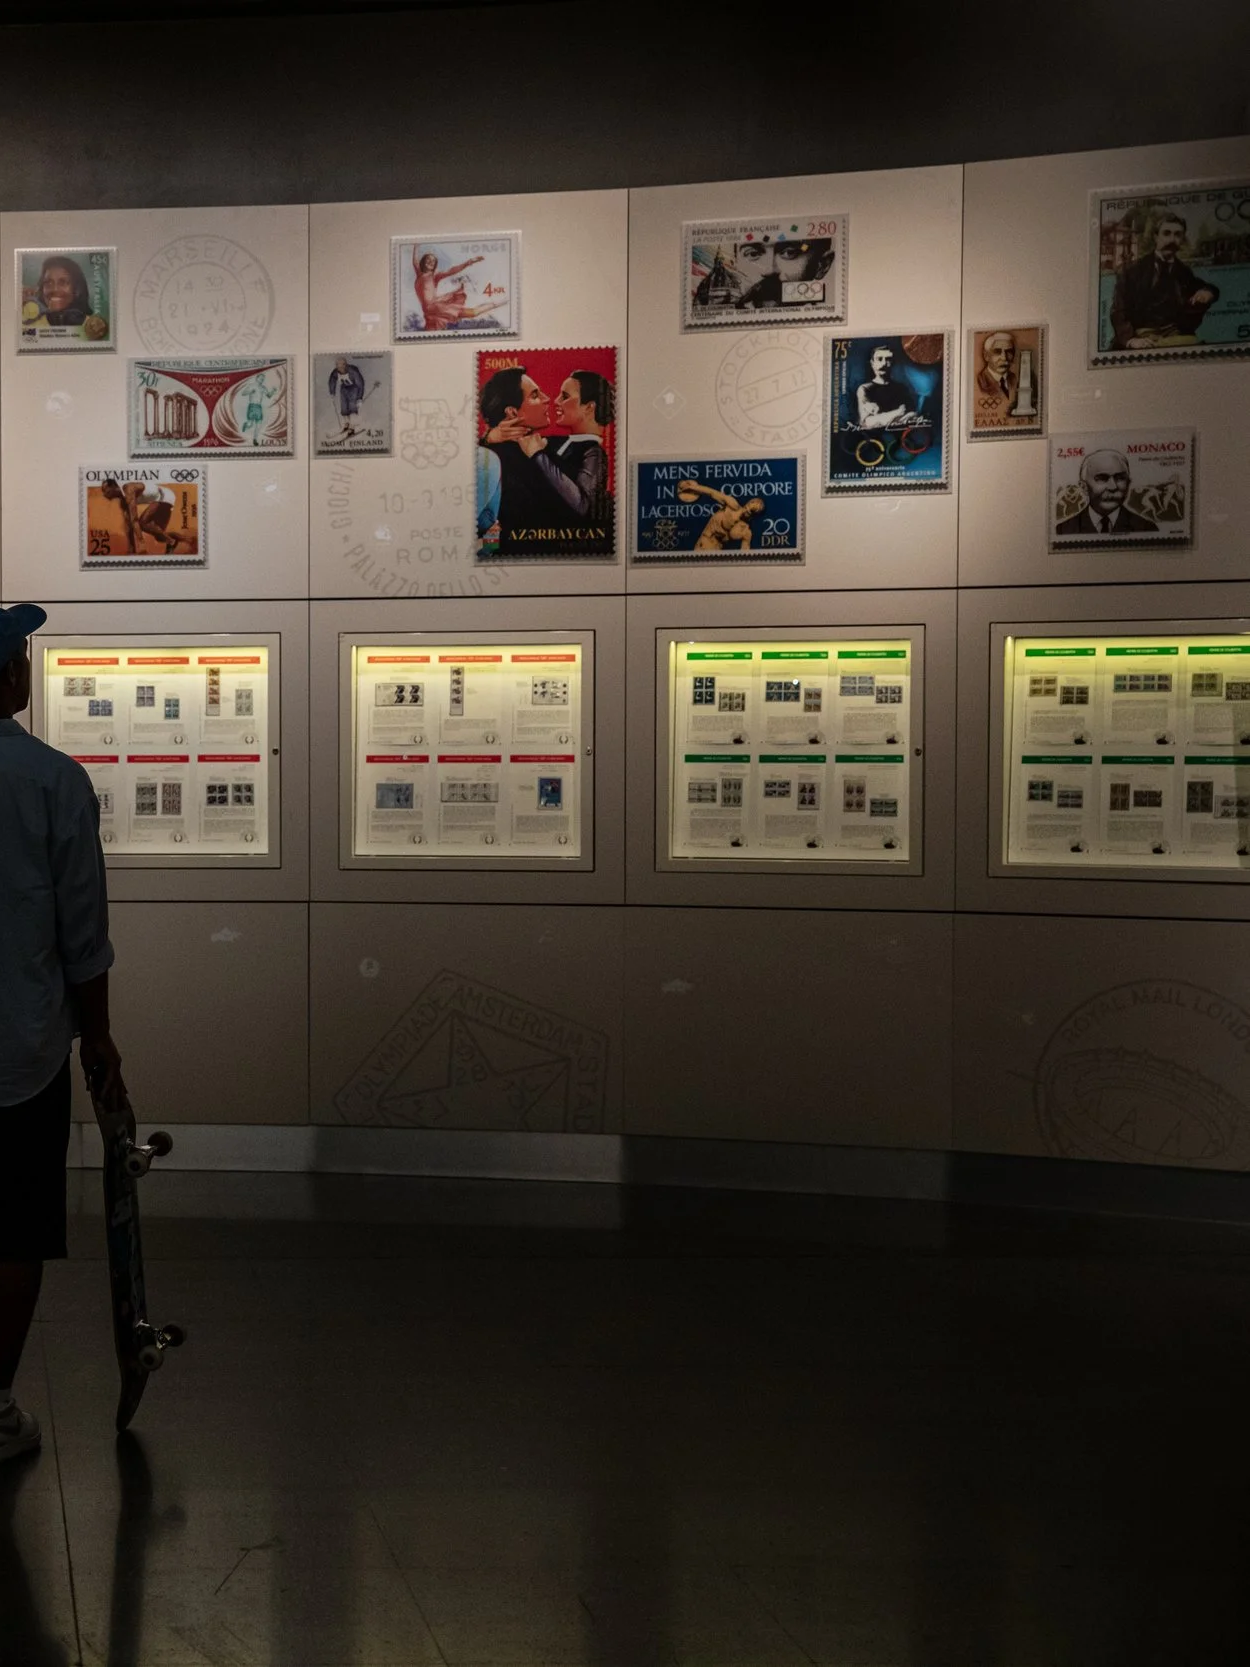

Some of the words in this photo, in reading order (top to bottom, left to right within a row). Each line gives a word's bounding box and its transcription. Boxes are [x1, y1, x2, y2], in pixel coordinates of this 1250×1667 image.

[461, 243, 507, 254] NORGE
[484, 357, 519, 370] 500M
[191, 376, 230, 384] MARATHON
[744, 402, 823, 444] STADIO
[349, 439, 384, 448] FINLAND
[1057, 446, 1086, 460] 2,55€
[1126, 441, 1186, 454] MONACO
[85, 469, 160, 481] OLYMPIAN
[654, 464, 700, 480] MENS
[705, 462, 772, 478] FERVIDA
[657, 484, 675, 500] IN
[720, 481, 794, 498] CORPORE
[641, 503, 722, 519] LACERTOSO
[90, 530, 111, 538] USA
[410, 526, 463, 541] POSTE
[762, 518, 790, 536] 20
[90, 538, 111, 556] 25
[761, 535, 790, 546] DDR
[1131, 986, 1186, 1008] MAIL
[451, 983, 584, 1053] AMSTERDAM
